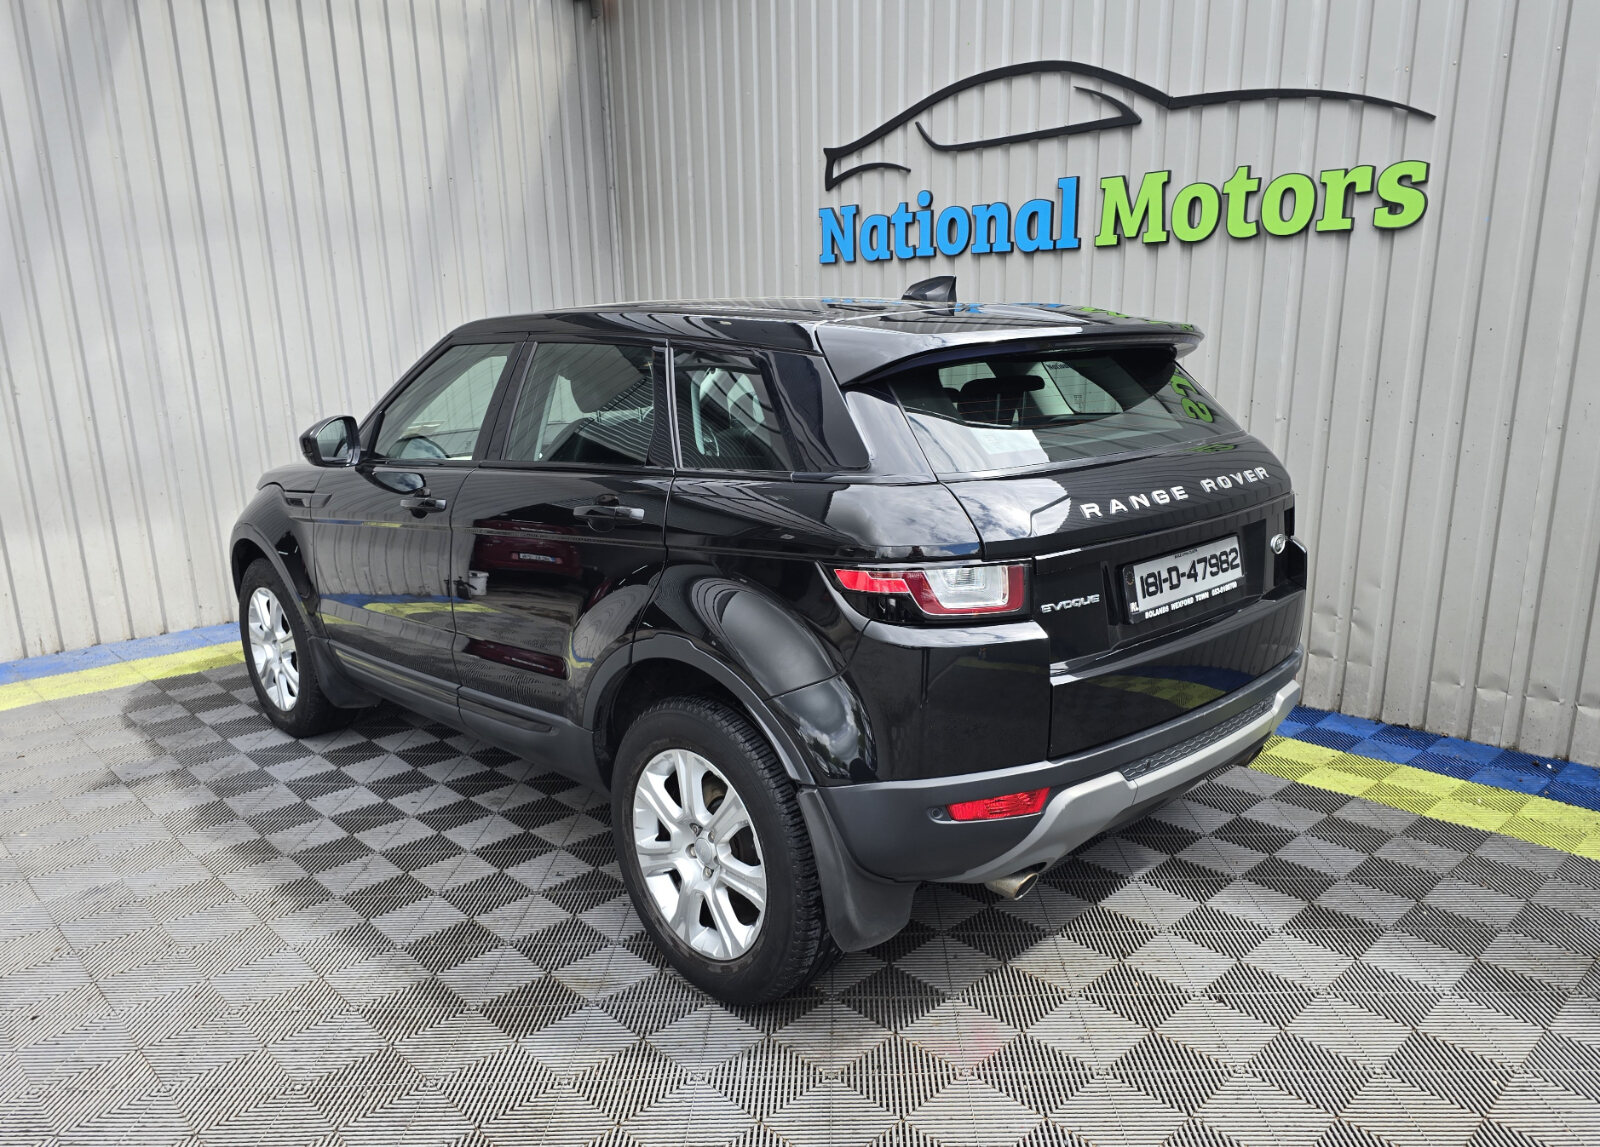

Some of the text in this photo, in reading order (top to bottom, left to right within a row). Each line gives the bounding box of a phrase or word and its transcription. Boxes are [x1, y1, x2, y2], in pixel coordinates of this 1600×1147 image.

[818, 160, 1430, 264] National Motors
[1080, 466, 1270, 520] RANGE ROVER
[1140, 547, 1240, 599] 181-D-47982
[1040, 593, 1100, 614] EVOQUE
